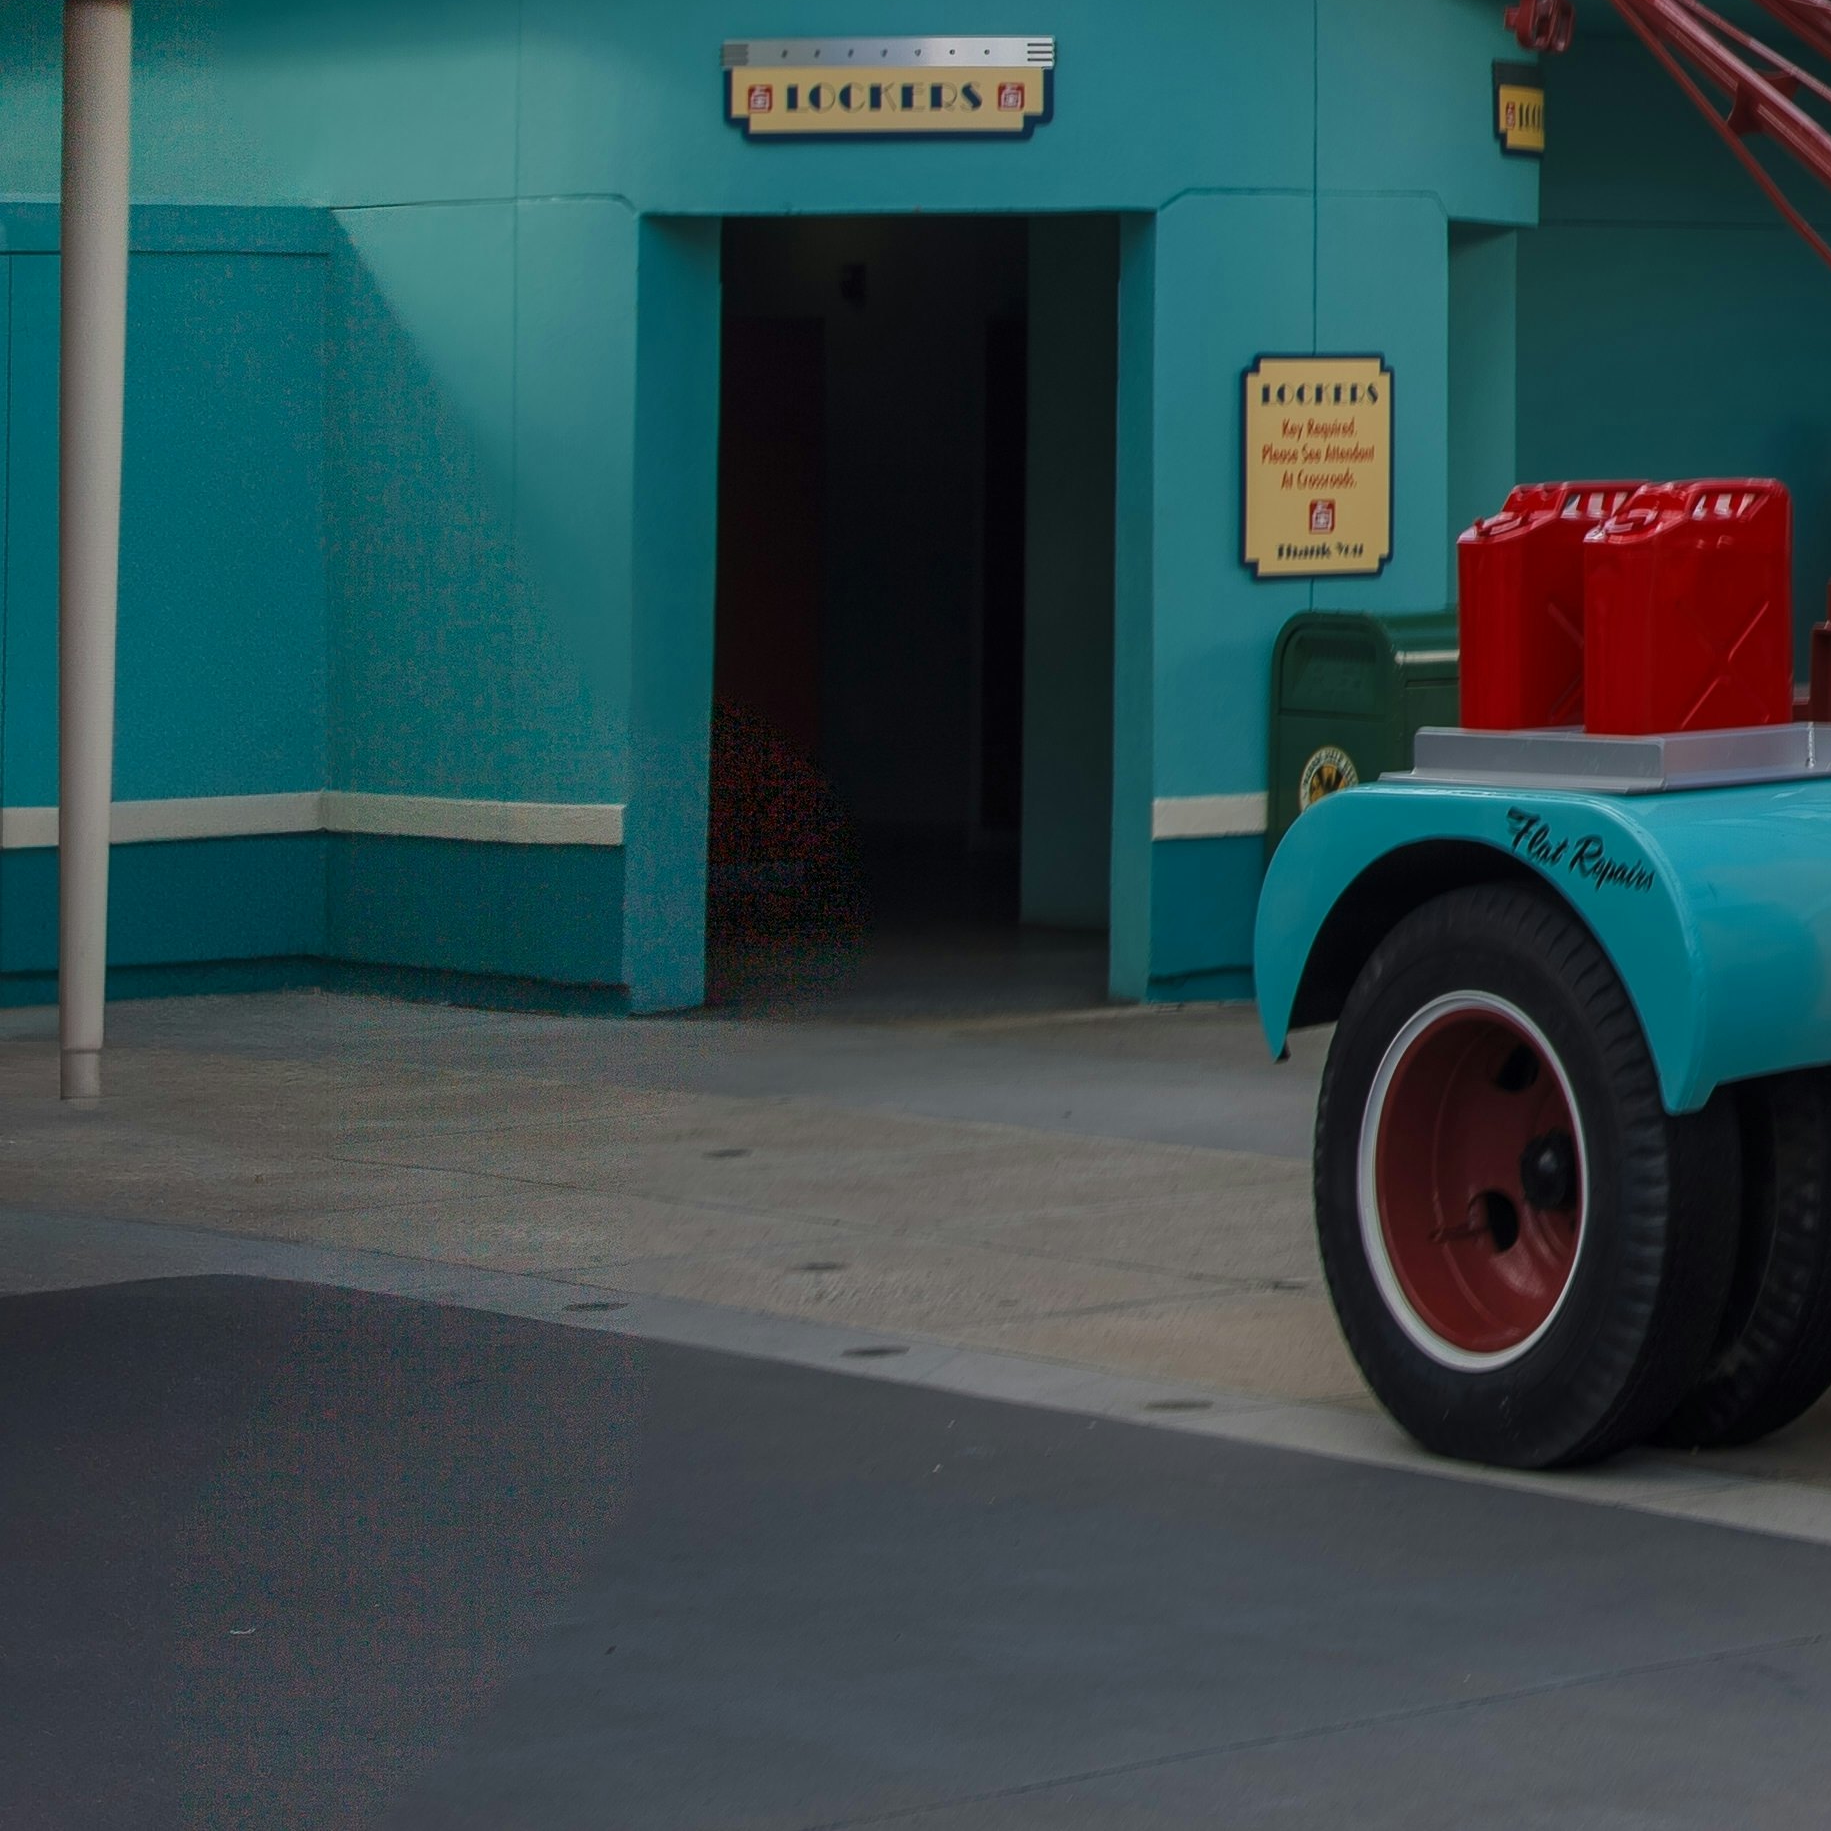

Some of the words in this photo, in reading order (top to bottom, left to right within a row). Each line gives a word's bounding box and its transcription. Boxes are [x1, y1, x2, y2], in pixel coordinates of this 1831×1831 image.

[786, 81, 983, 113] LOCKERS
[1261, 382, 1378, 406] LOCKERS
[1282, 417, 1303, 441] Key
[1261, 442, 1298, 465] Please
[1301, 443, 1321, 465] See
[1324, 441, 1375, 464] Attendant
[1281, 470, 1293, 490] At
[1506, 805, 1569, 866] Flat
[1569, 834, 1655, 893] Repairs
